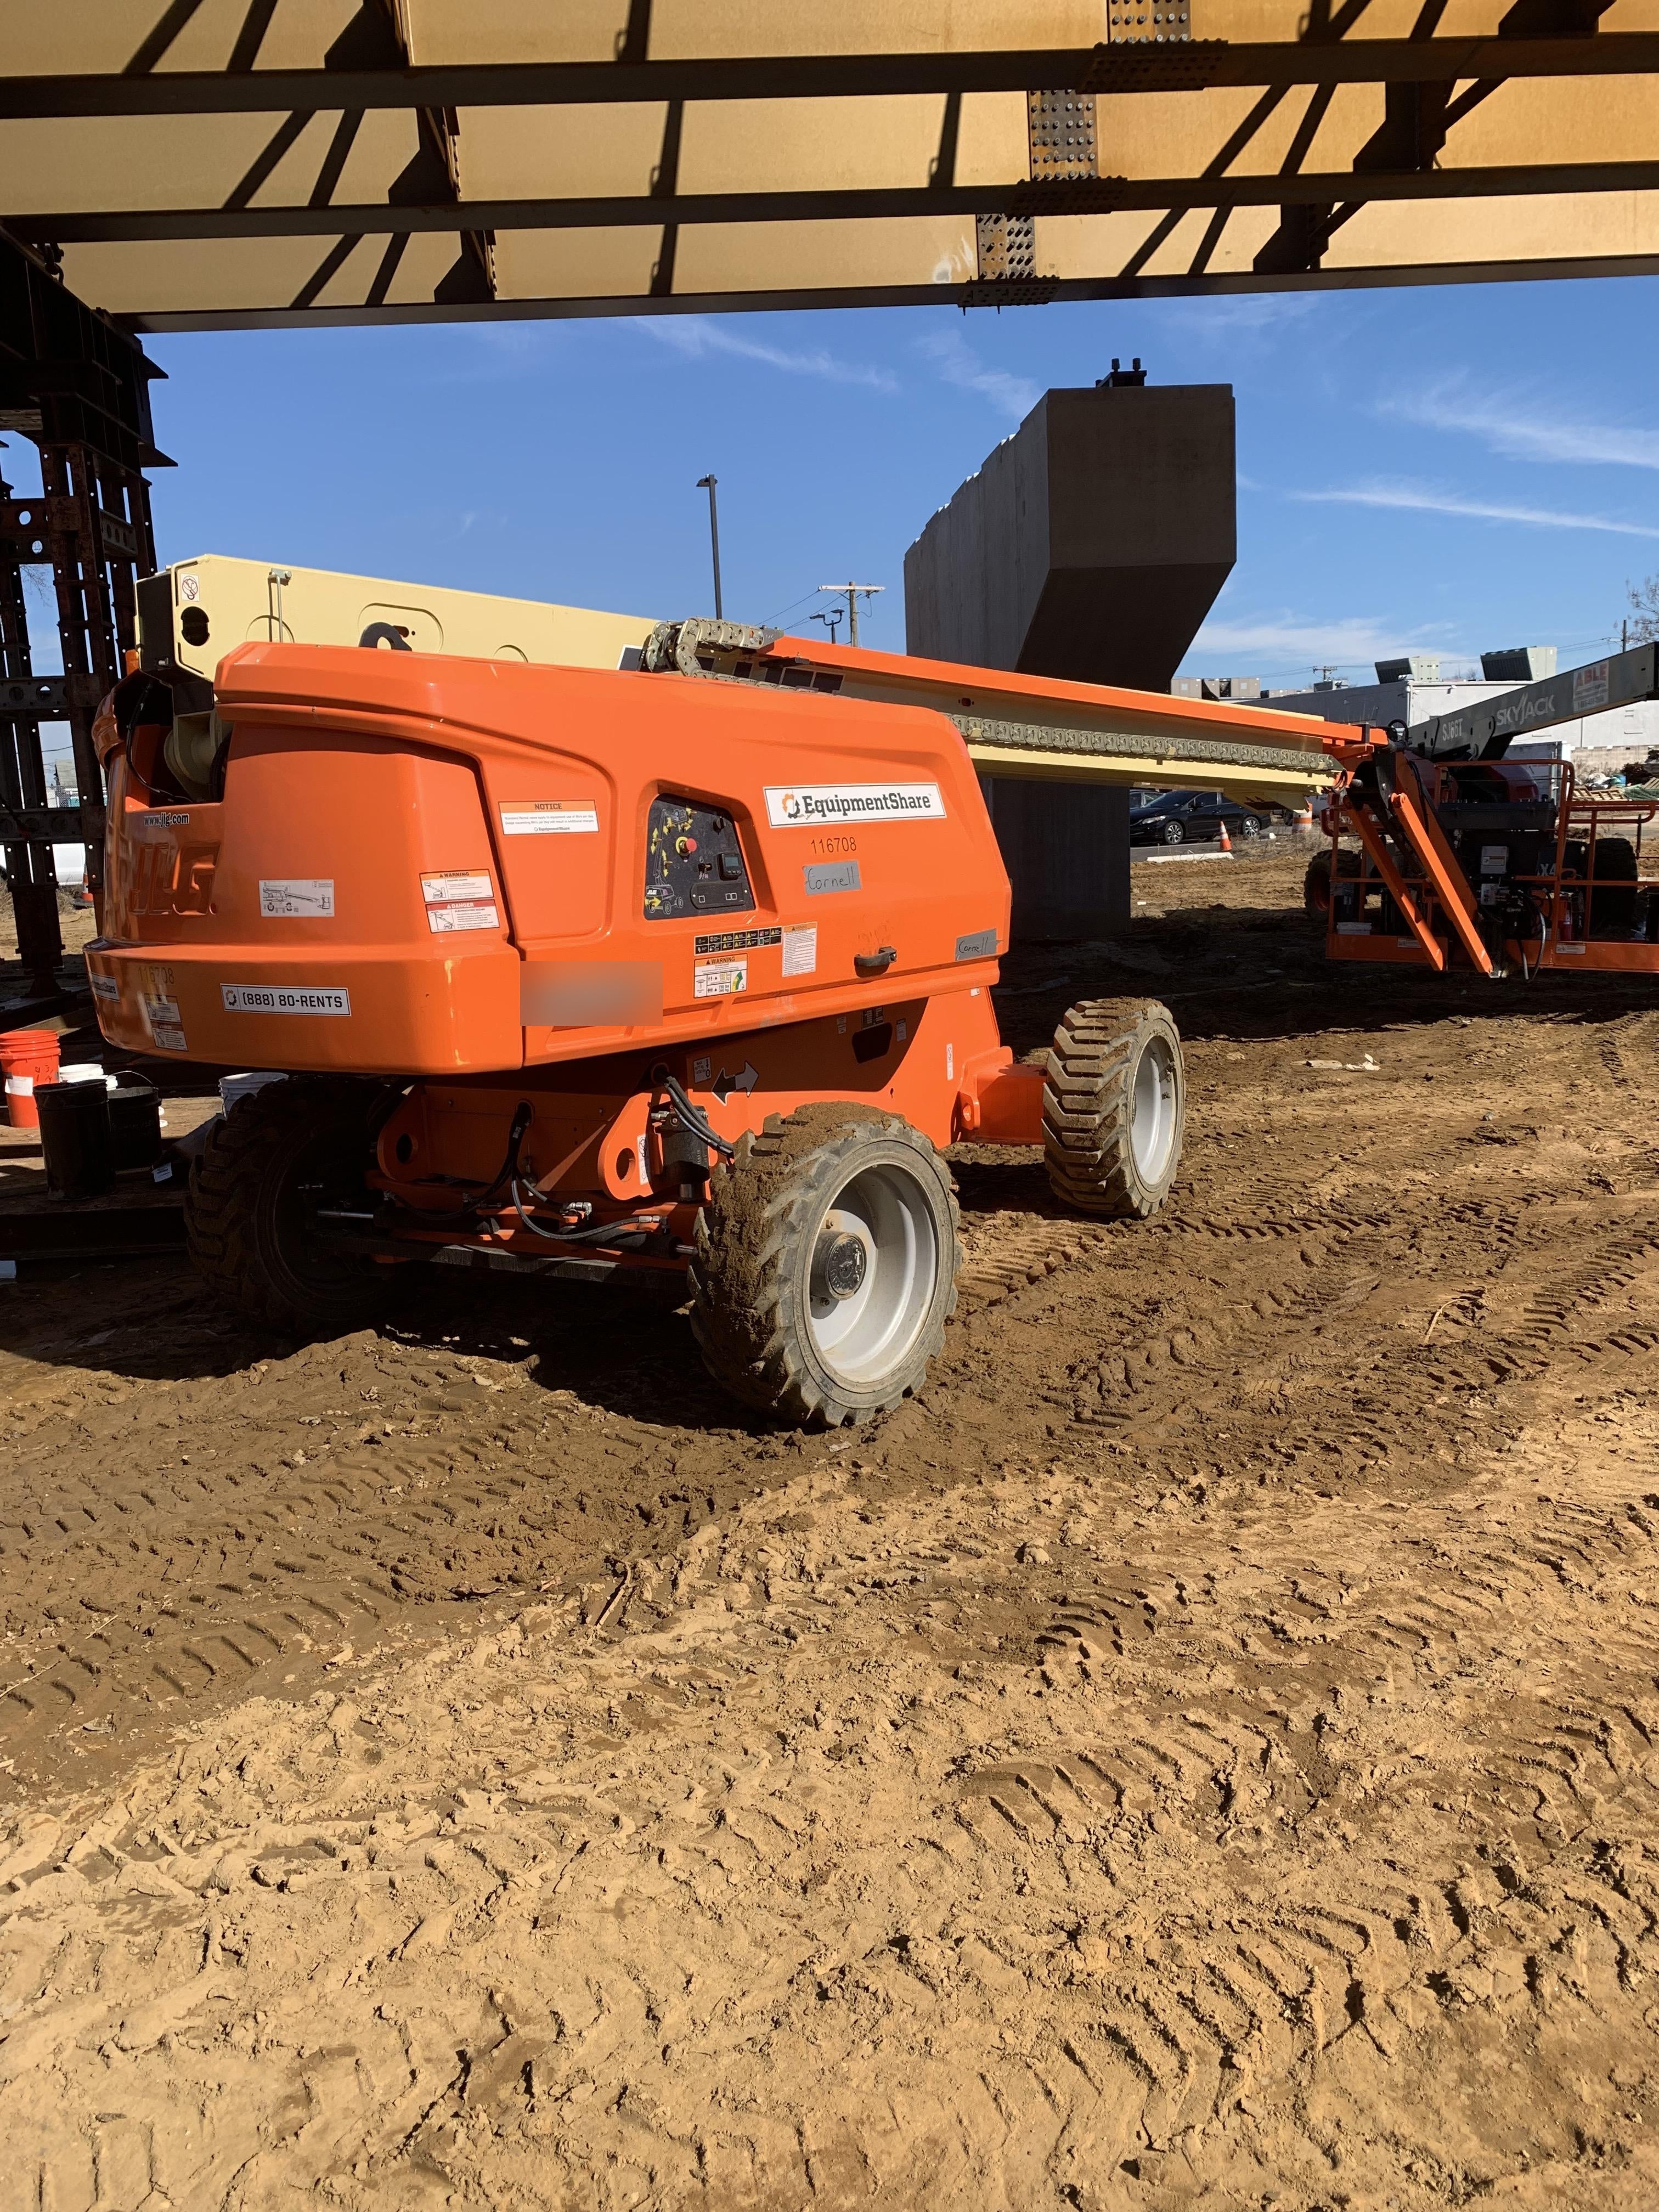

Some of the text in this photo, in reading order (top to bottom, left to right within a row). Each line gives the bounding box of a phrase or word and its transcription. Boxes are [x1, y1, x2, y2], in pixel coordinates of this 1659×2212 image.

[1496, 693, 1555, 726] SKYJACK
[802, 793, 932, 817] EquipmentShare
[144, 812, 190, 828] www.jlg.com
[811, 837, 857, 854] 116708
[808, 866, 855, 890] Cornell
[711, 956, 736, 965] WARNING
[139, 966, 175, 985] 116708
[242, 992, 343, 1008] (888) 80-RENTS
